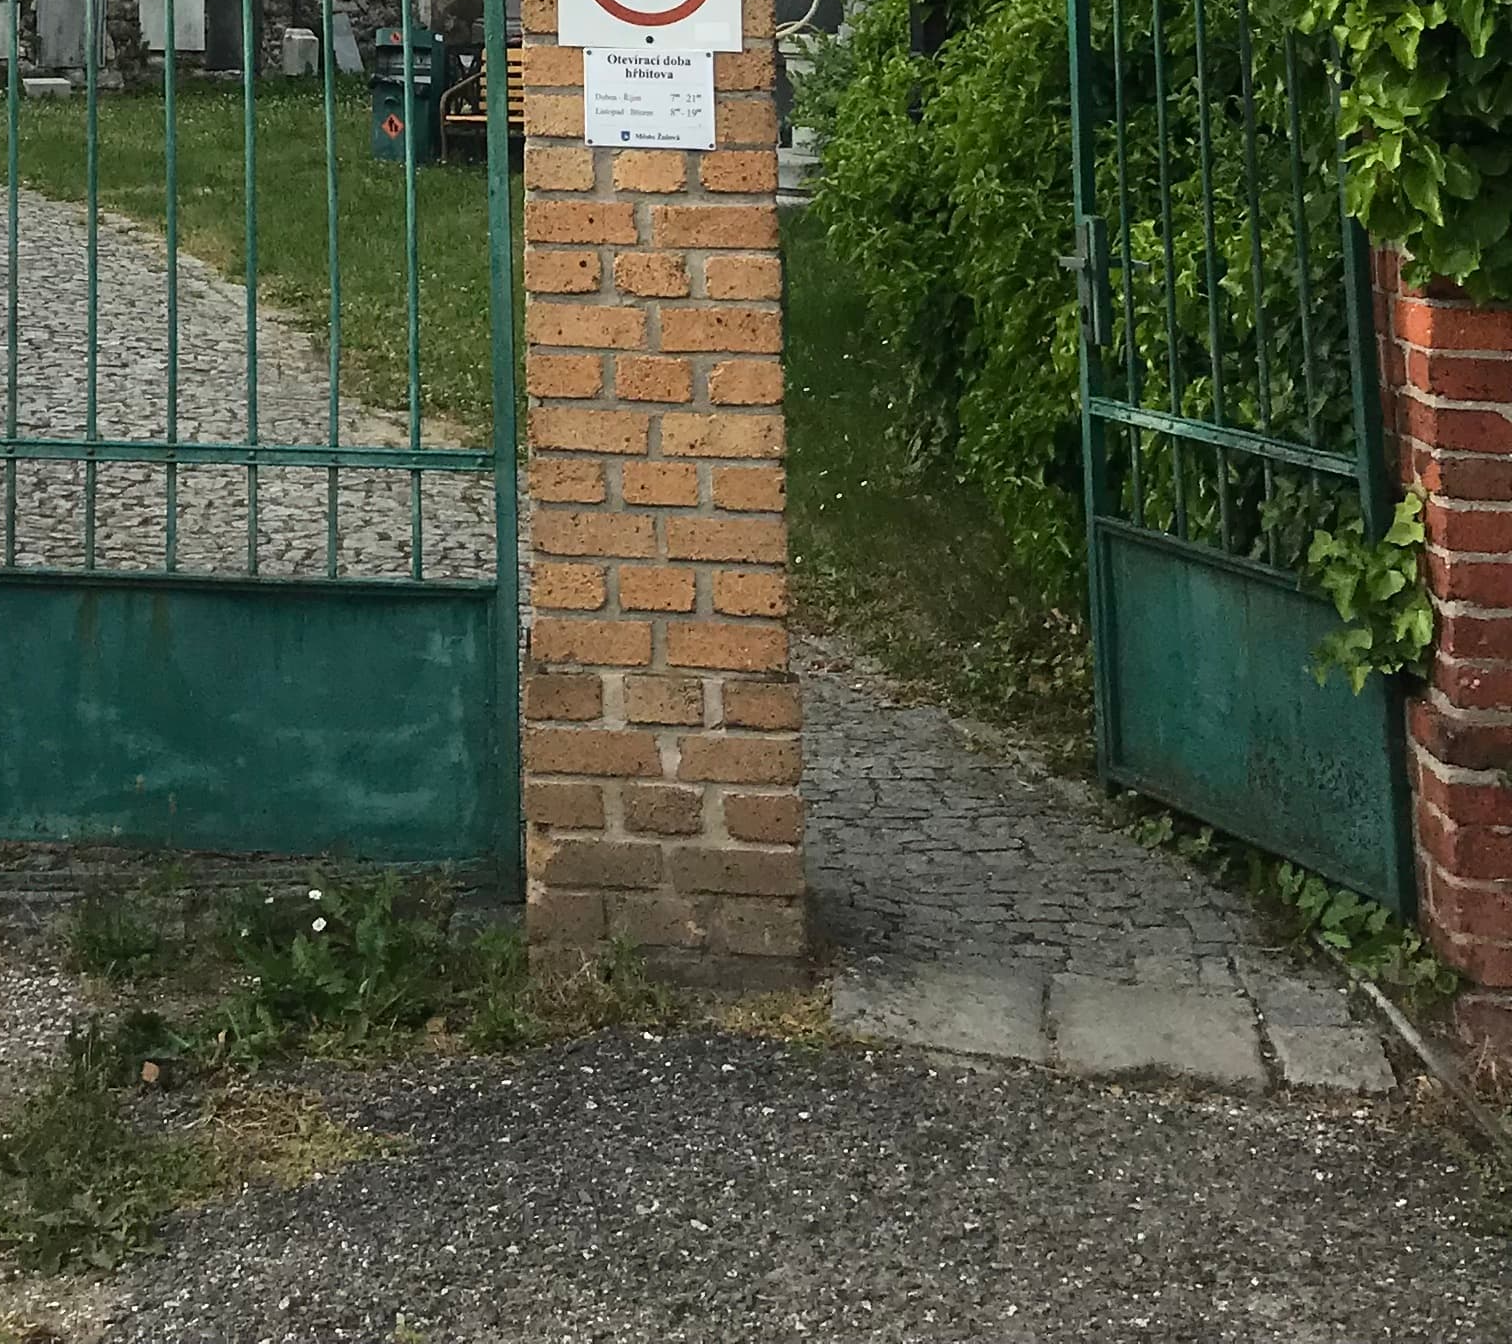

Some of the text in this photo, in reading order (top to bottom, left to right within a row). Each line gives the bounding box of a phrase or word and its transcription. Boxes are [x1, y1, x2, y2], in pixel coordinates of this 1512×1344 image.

[607, 53, 692, 66] Otevírací doba
[625, 67, 674, 79] hřbitova
